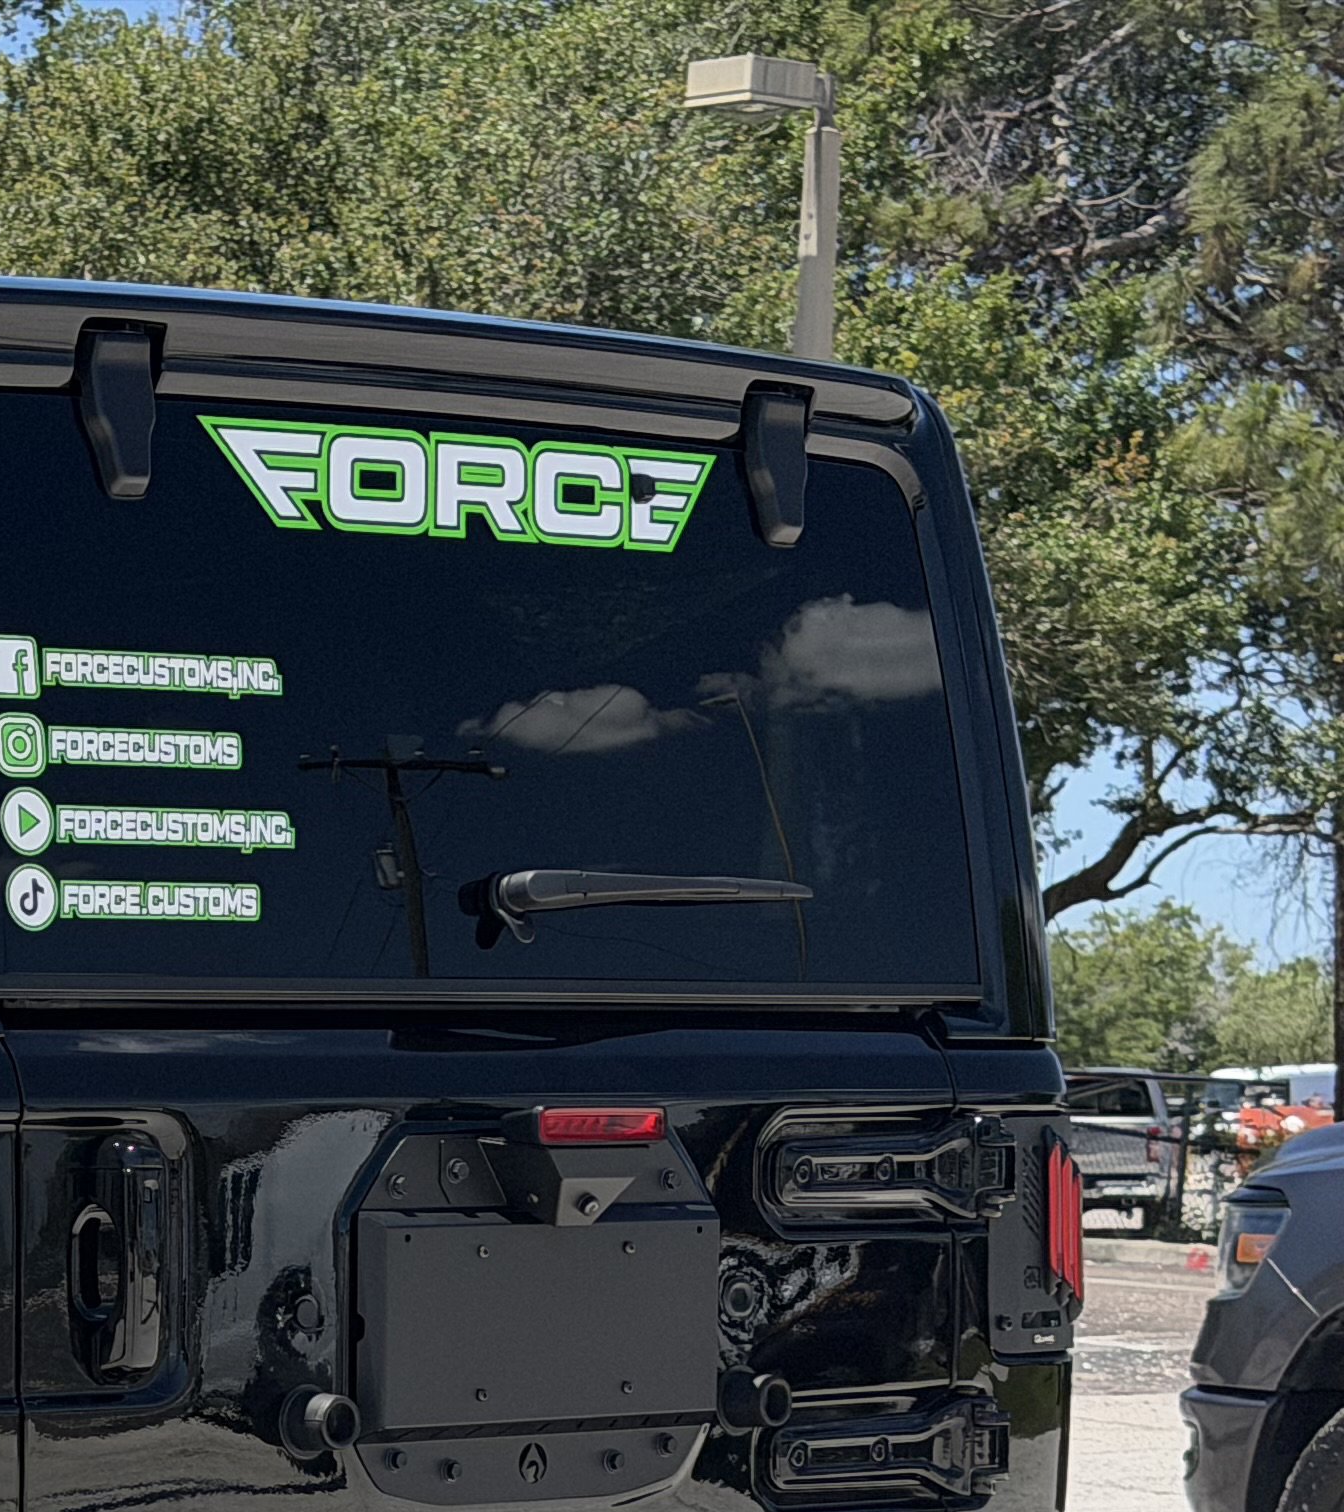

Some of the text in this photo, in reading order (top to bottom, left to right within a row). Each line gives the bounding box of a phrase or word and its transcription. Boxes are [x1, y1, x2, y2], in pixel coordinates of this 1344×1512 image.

[217, 426, 703, 544] FORCE
[51, 731, 239, 766] FORCECUSTOMS
[63, 884, 258, 917] FORCE.CUSTOMS
